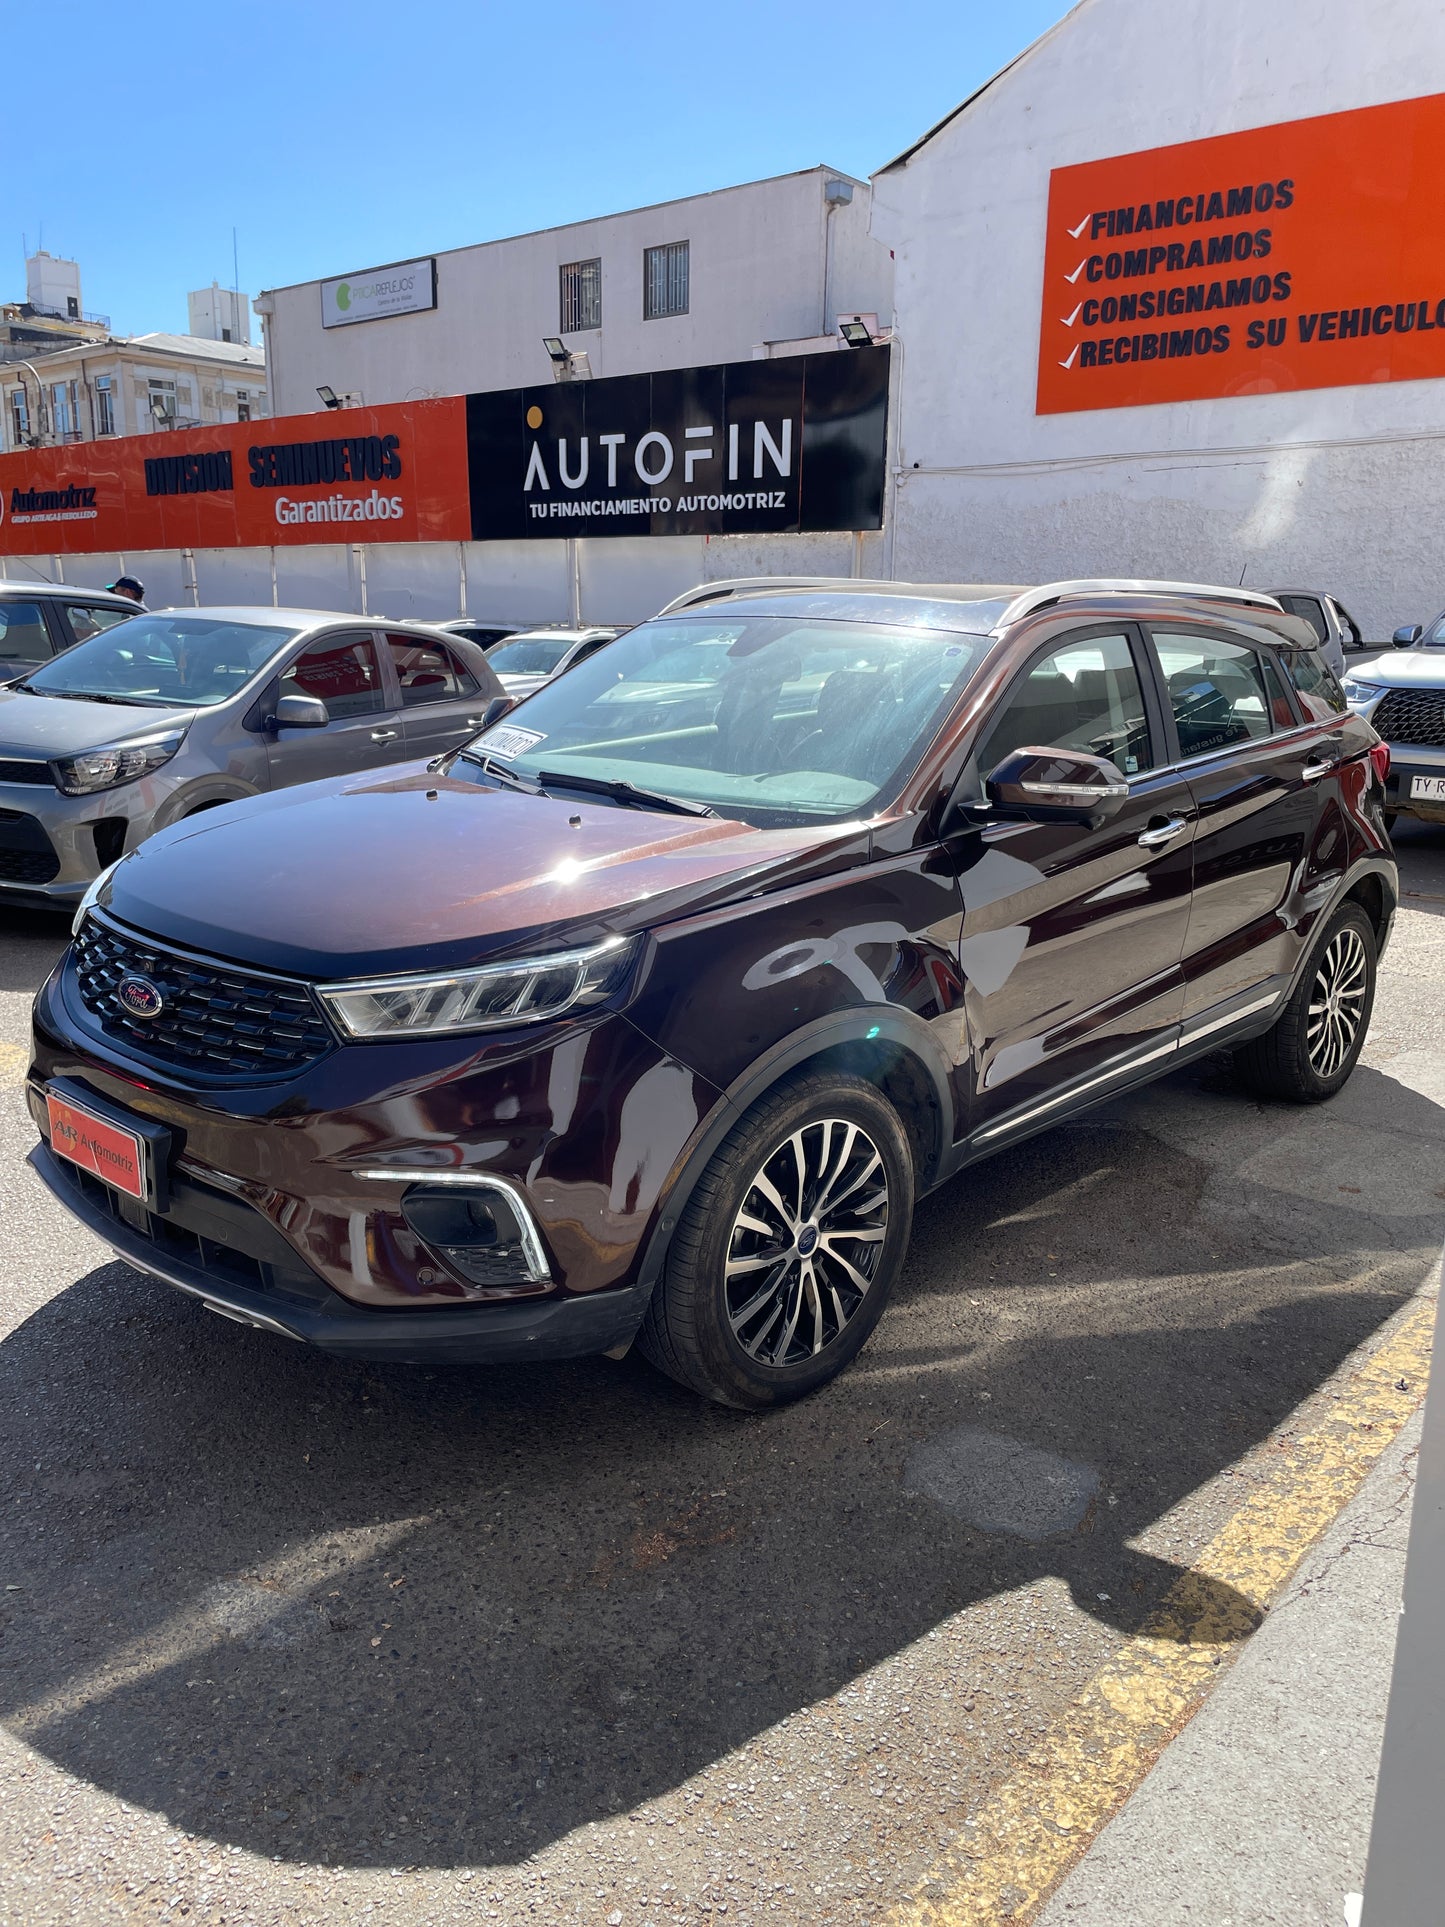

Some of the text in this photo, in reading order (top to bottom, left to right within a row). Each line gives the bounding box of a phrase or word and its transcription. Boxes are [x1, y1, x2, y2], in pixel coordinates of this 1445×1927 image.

[1090, 178, 1295, 240] FINANCIAMOS
[1086, 229, 1272, 283] COMPRAMOS
[1082, 272, 1292, 326] CONSIGNAMOS
[1080, 325, 1230, 368] RECIBIMOS
[1247, 317, 1287, 350] SU
[144, 434, 402, 497] DIVISION SEMINUEVOS
[523, 418, 792, 491] AUTOFIN
[10, 483, 97, 513] Automotriz
[275, 489, 403, 525] Garantizados
[530, 491, 786, 519] TU FINANCIAMIENTO AUTOMOTRIZ
[1415, 778, 1432, 792] TY
[125, 984, 150, 1009] Ford
[80, 1134, 133, 1172] Automotriz
